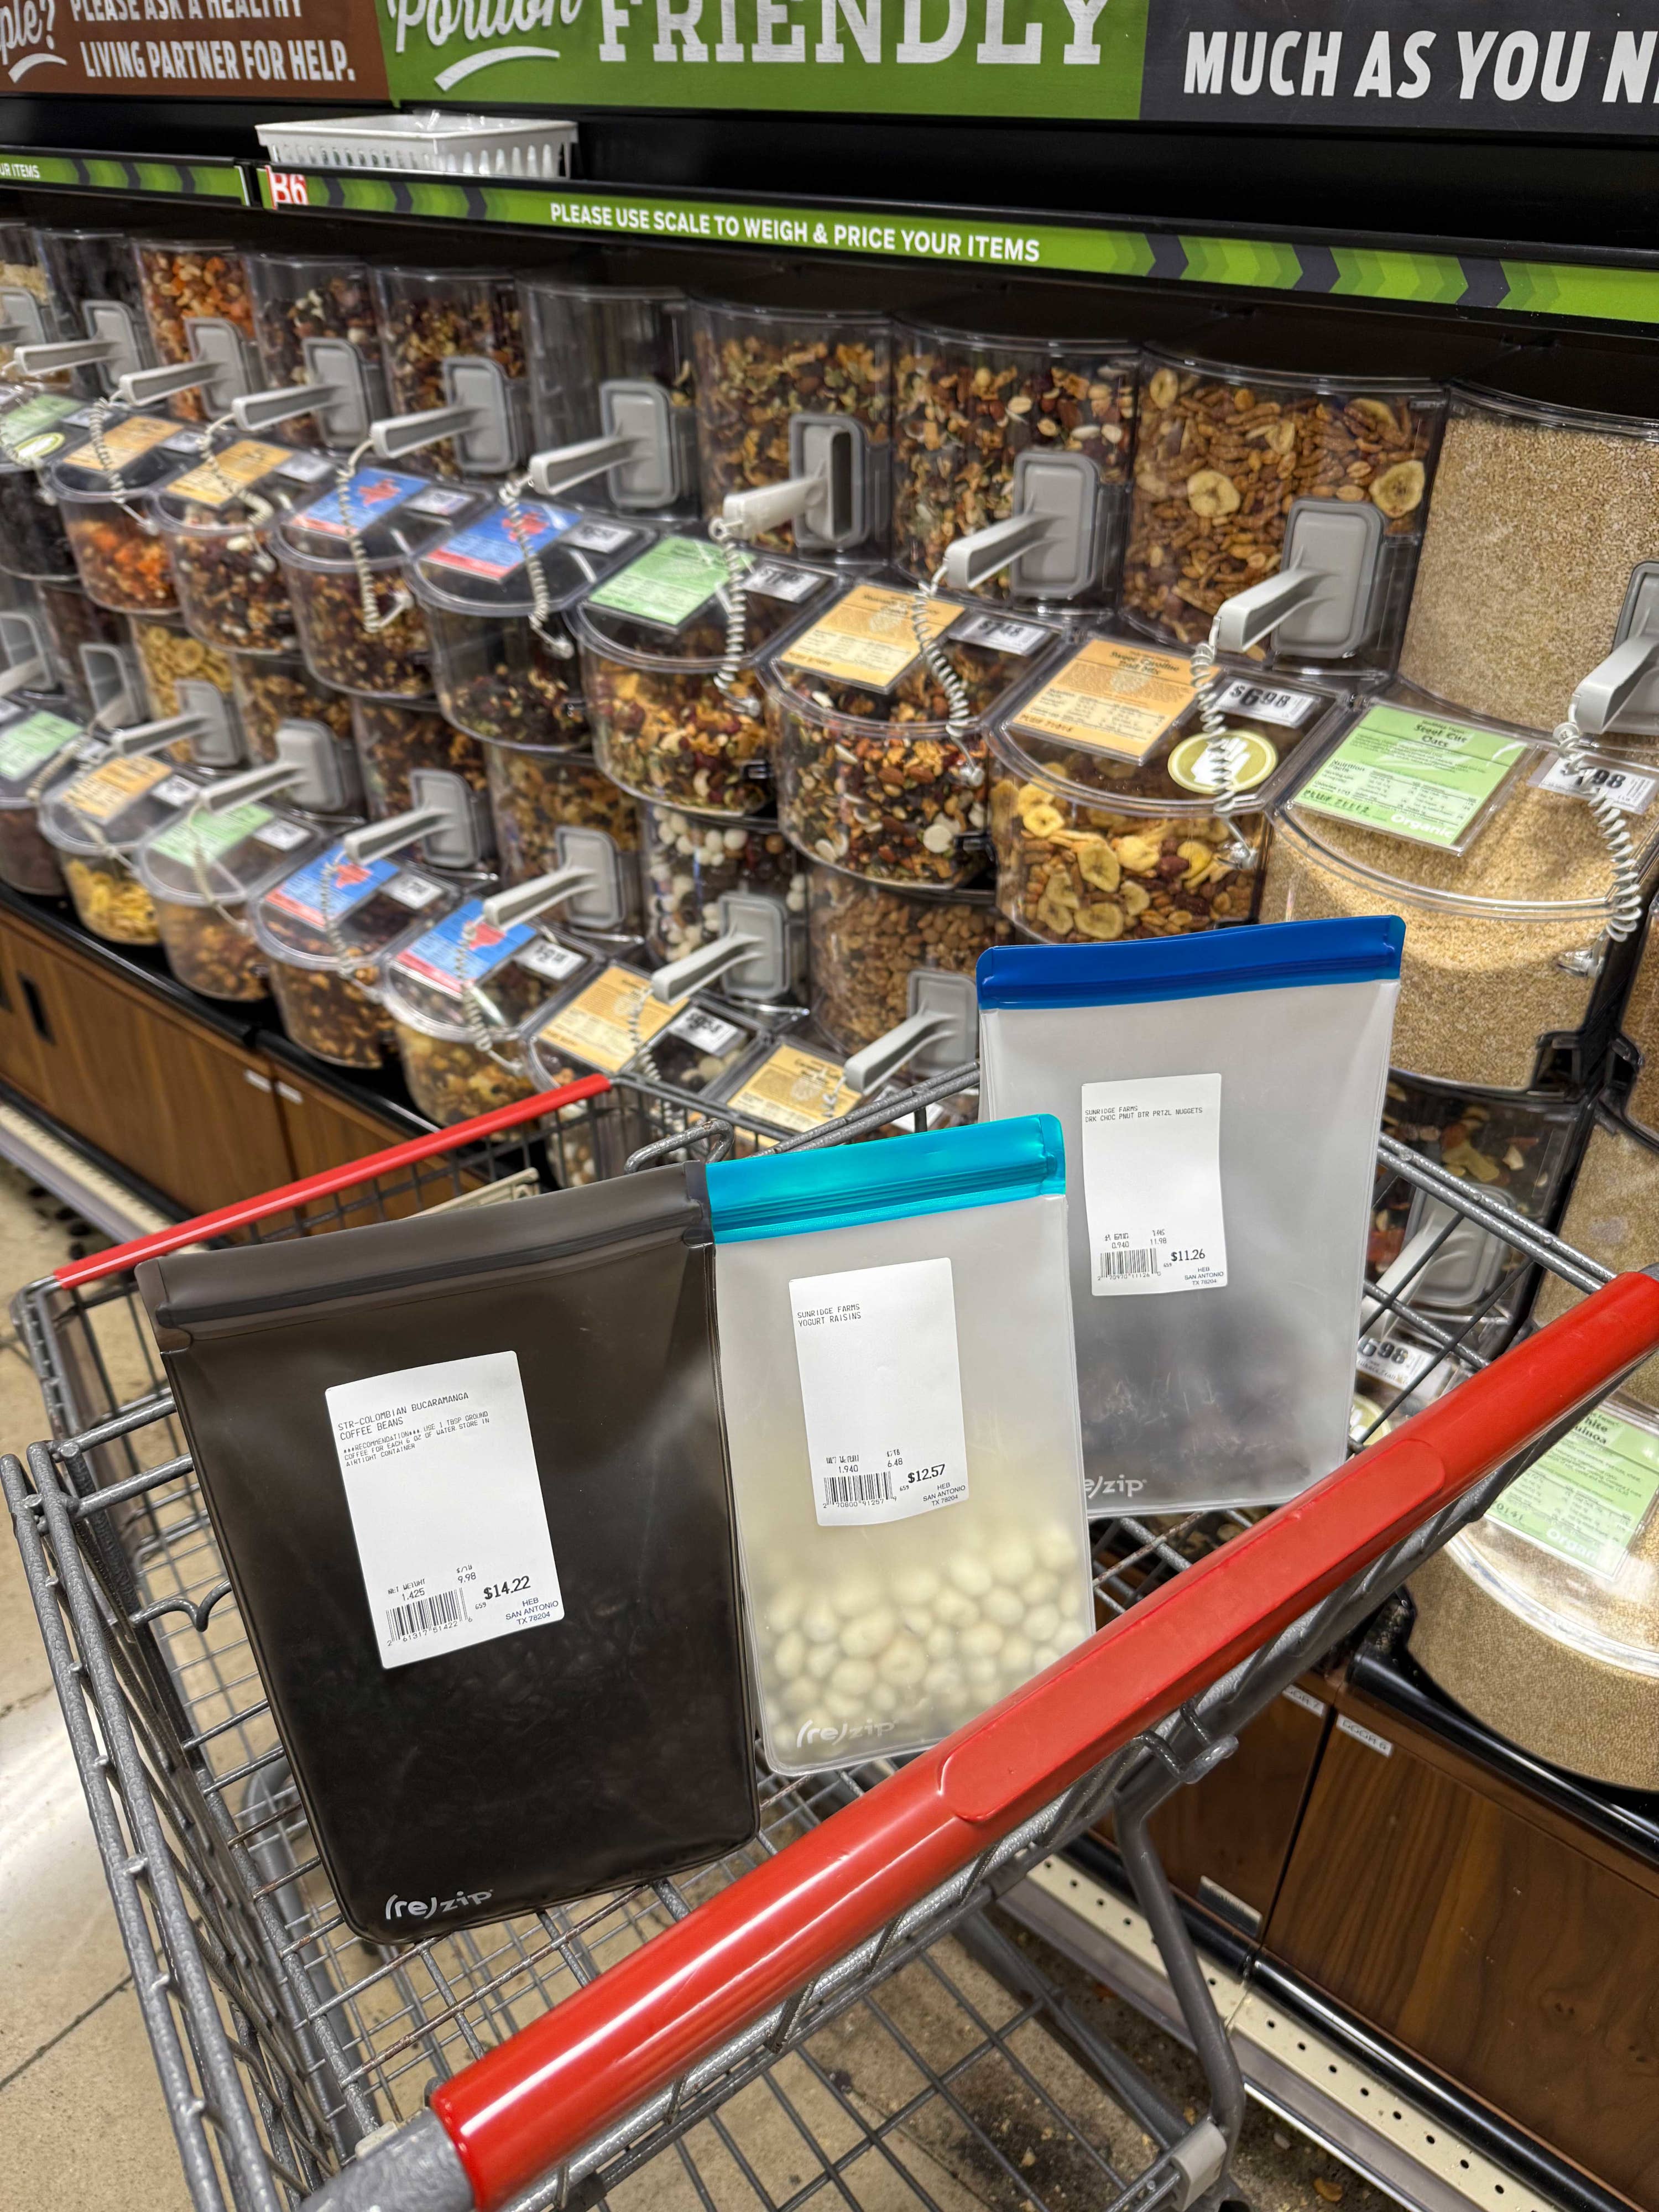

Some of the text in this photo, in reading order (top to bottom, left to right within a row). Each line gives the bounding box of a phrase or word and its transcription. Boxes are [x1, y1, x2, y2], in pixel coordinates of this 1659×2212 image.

[70, 0, 141, 21] PLEASE
[599, 0, 1108, 65] FRIENDLY
[80, 40, 356, 82] LIVING PARTNER FOR HELP.
[1183, 30, 1659, 104] MUCH AS YOU N
[12, 163, 41, 179] ITEMS
[269, 173, 309, 205] B6
[550, 202, 1041, 262] PLEASE USE SCALE TO WEIGH & PRICE YOUR ITEMS
[1391, 813, 1455, 839] Organic
[1085, 1107, 1115, 1115] SUNRIDGE
[1171, 1249, 1206, 1261] $11.26
[797, 1303, 860, 1318] SUNRIDGE FARMS
[798, 1312, 861, 1327] YOGURT RAISINS
[338, 1392, 469, 1431] STR-COLOMBIAN BUCARAMANGA
[340, 1417, 404, 1441] COFFEE BEANS
[424, 1423, 436, 1432] USE
[447, 1417, 462, 1426] TBSP
[1585, 1416, 1608, 1432] hite
[344, 1449, 368, 1461] COFFEE
[372, 1444, 384, 1454] FOR
[387, 1440, 403, 1450] EACH
[459, 1420, 478, 1430] STORE
[1575, 1426, 1606, 1444] uinoa
[381, 1443, 415, 1458] CONTAINER
[839, 1458, 903, 1473] 1.940 6.48
[907, 1464, 946, 1484] $12.57
[923, 1485, 966, 1502] SAN ANTONIO
[937, 1482, 950, 1490] HEB
[1084, 1474, 1144, 1500] e)zip
[941, 1495, 958, 1504] 78204
[402, 1572, 477, 1601] 1.425 9.98
[483, 1575, 531, 1600] $14.22
[505, 1600, 559, 1620] SAN ANTONIO
[523, 1597, 539, 1607] HEB
[516, 1611, 551, 1625] TX 78204
[403, 1629, 428, 1642] 61317
[433, 1621, 458, 1634] 51422
[796, 1718, 896, 1748] (re)zip
[385, 1890, 493, 1921] (re)zip
